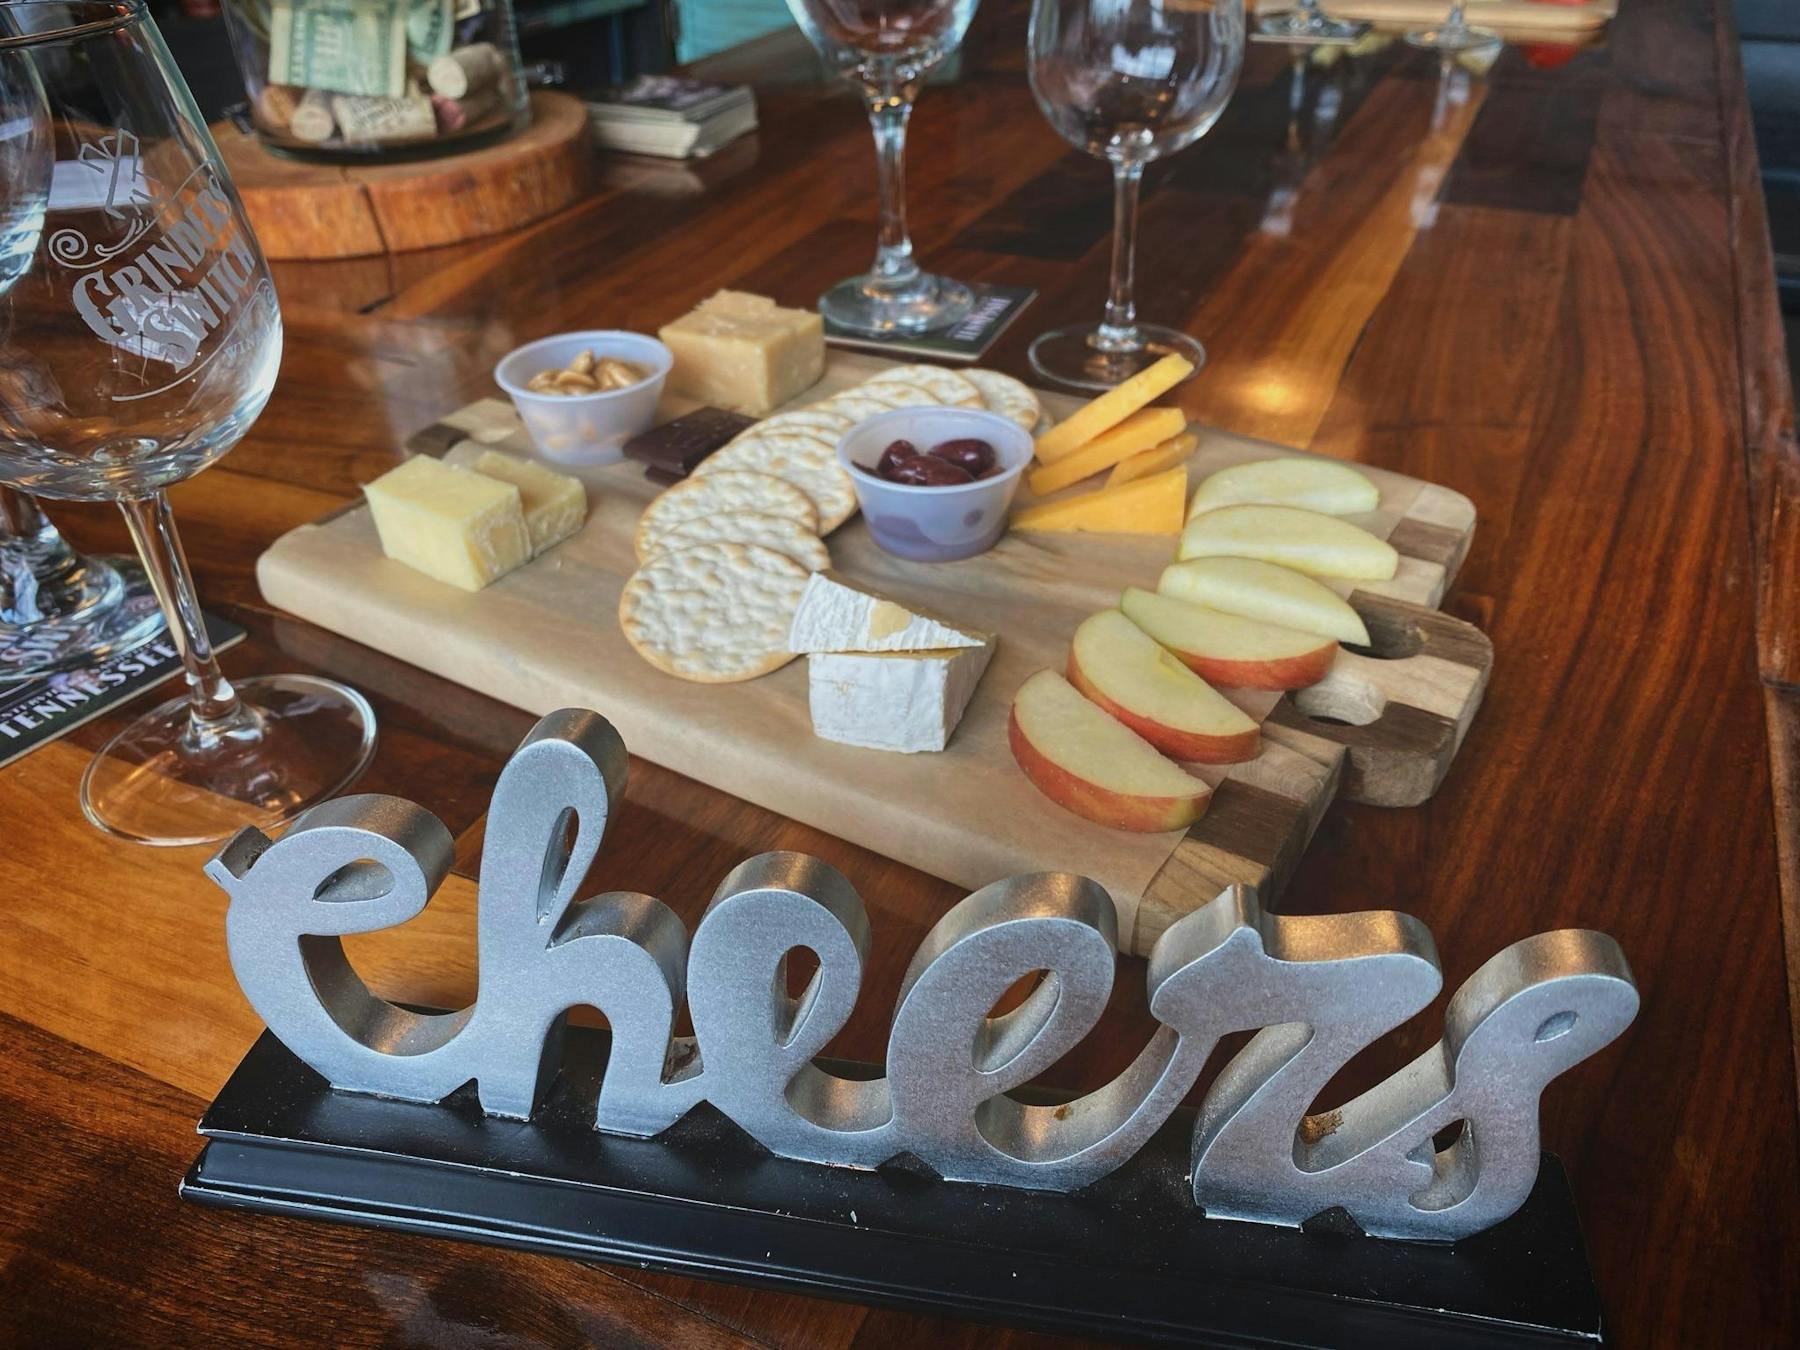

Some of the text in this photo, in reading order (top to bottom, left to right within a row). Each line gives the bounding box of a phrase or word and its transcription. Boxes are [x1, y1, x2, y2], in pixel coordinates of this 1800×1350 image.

[143, 231, 257, 374] SWITCH
[0, 643, 179, 739] TENNESSEE
[203, 708, 1641, 1245] cheers
